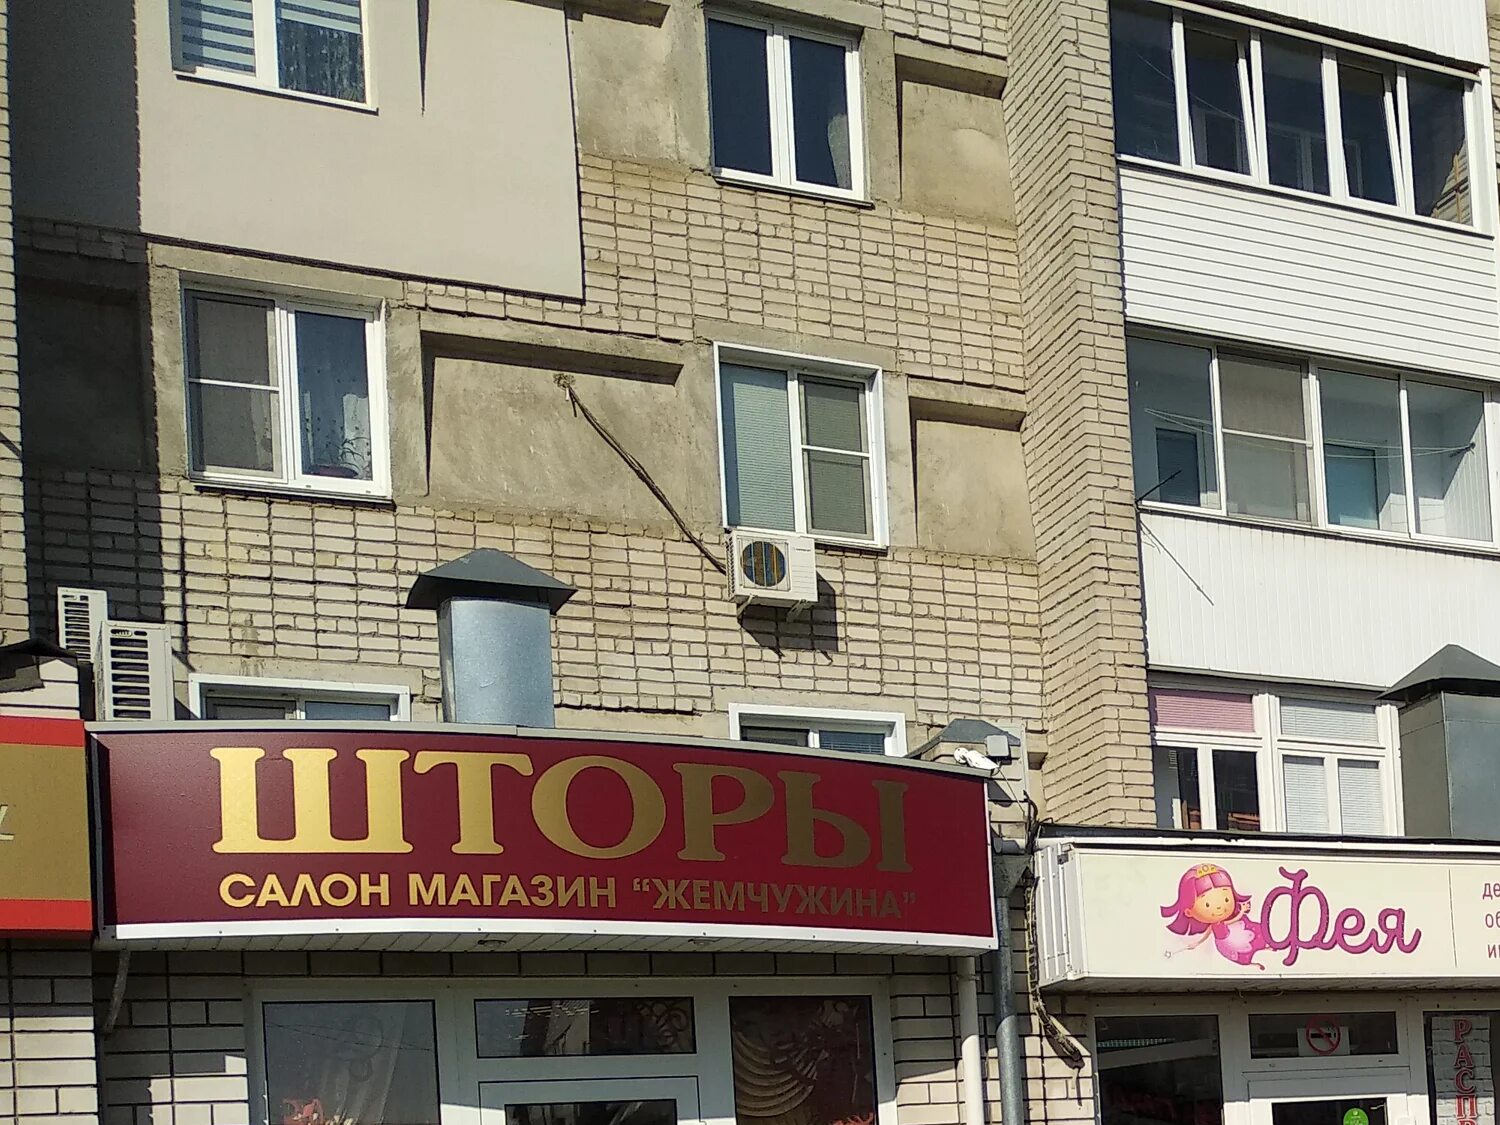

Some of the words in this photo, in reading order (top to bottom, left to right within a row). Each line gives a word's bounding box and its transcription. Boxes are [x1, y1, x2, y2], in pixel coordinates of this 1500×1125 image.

[210, 747, 913, 872] ШТОРЫ
[219, 873, 390, 907] САЛОН
[409, 873, 616, 908] МАГАЗИН
[1260, 866, 1422, 966] Фея
